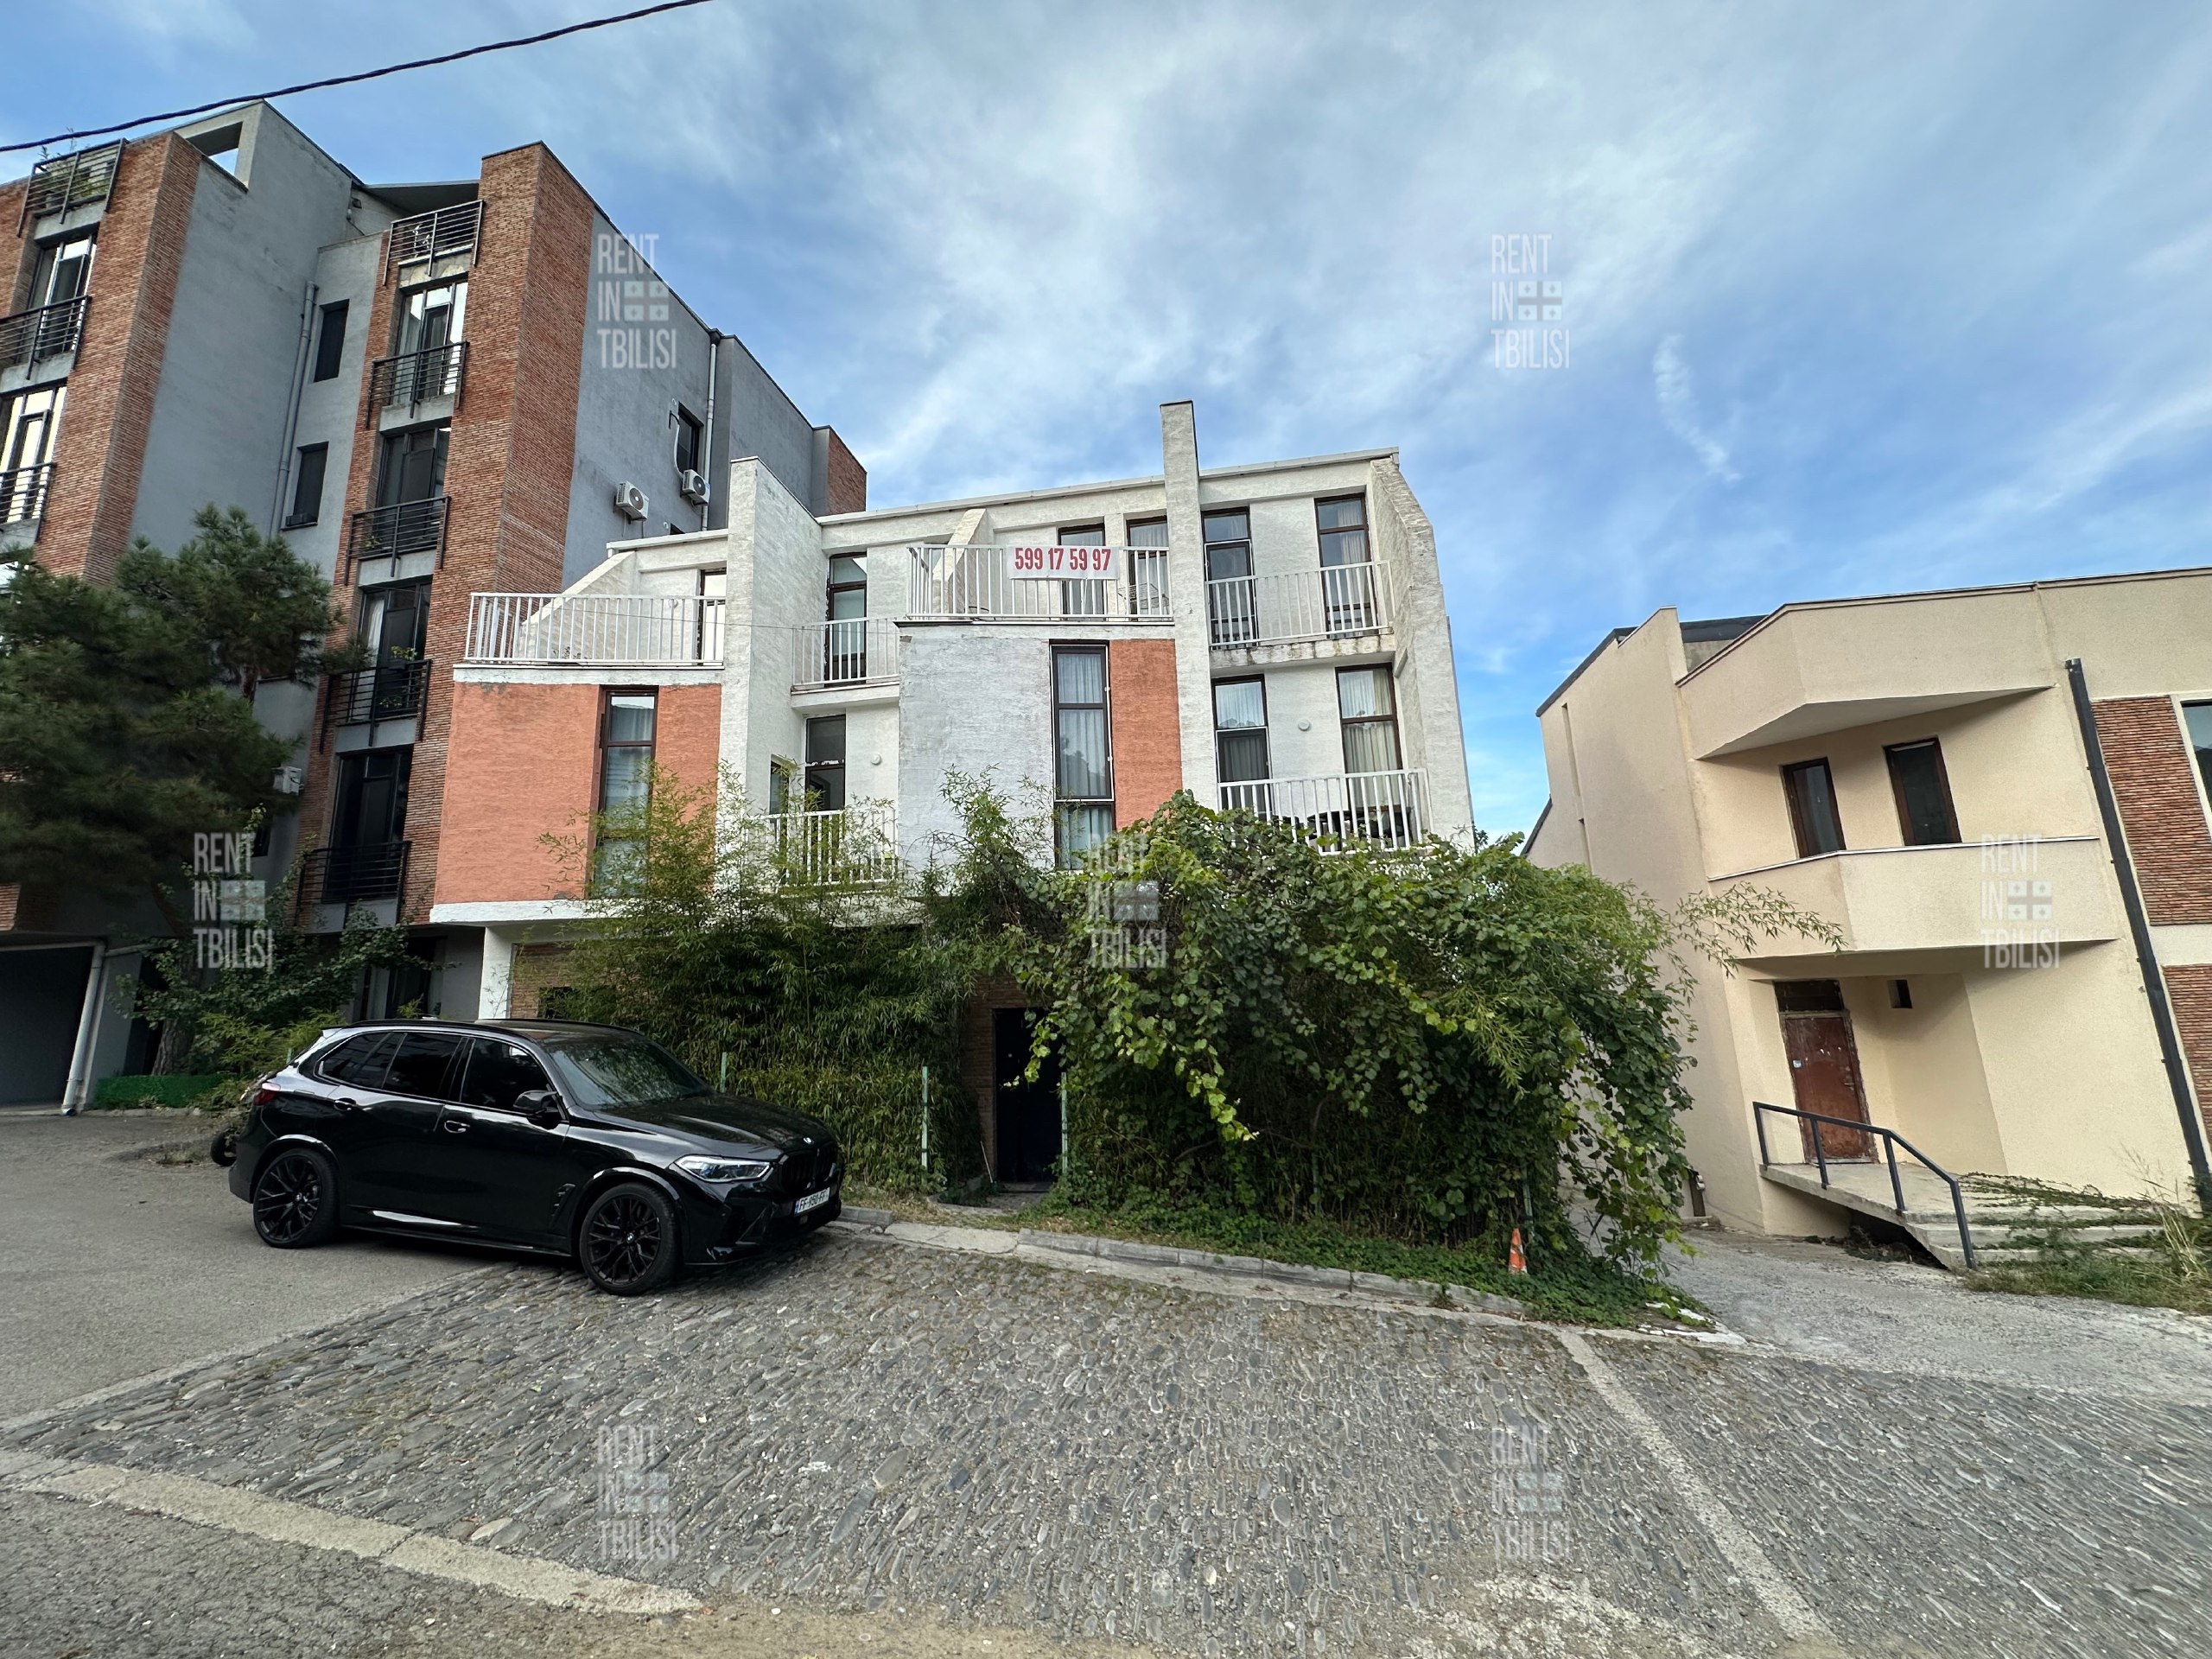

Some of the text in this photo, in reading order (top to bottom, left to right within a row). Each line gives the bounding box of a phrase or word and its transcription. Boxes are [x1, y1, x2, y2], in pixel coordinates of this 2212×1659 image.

[1014, 547, 1111, 571] 599 17 59 97
